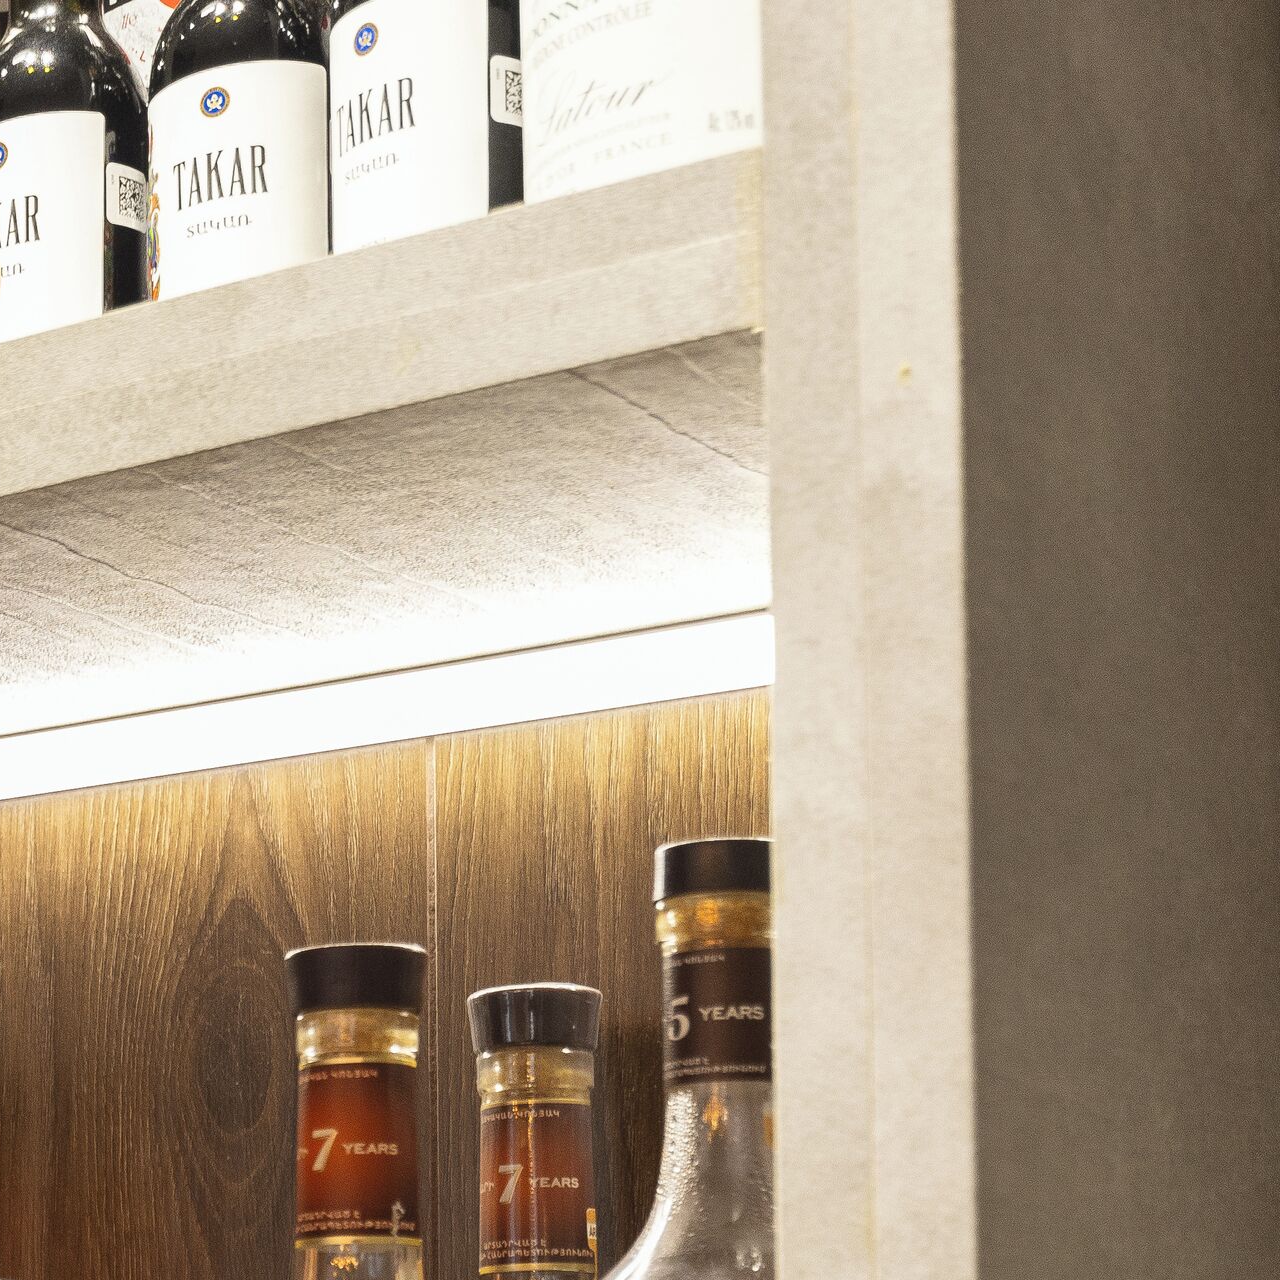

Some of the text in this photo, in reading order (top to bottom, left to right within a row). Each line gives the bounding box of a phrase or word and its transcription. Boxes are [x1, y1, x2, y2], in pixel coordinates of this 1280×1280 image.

[337, 77, 417, 158] TAKAR
[173, 144, 269, 212] TAKAR
[667, 996, 765, 1042] 5 YEARS
[311, 1127, 399, 1173] 7 YEARS
[498, 1163, 580, 1205] 7 YEARS
